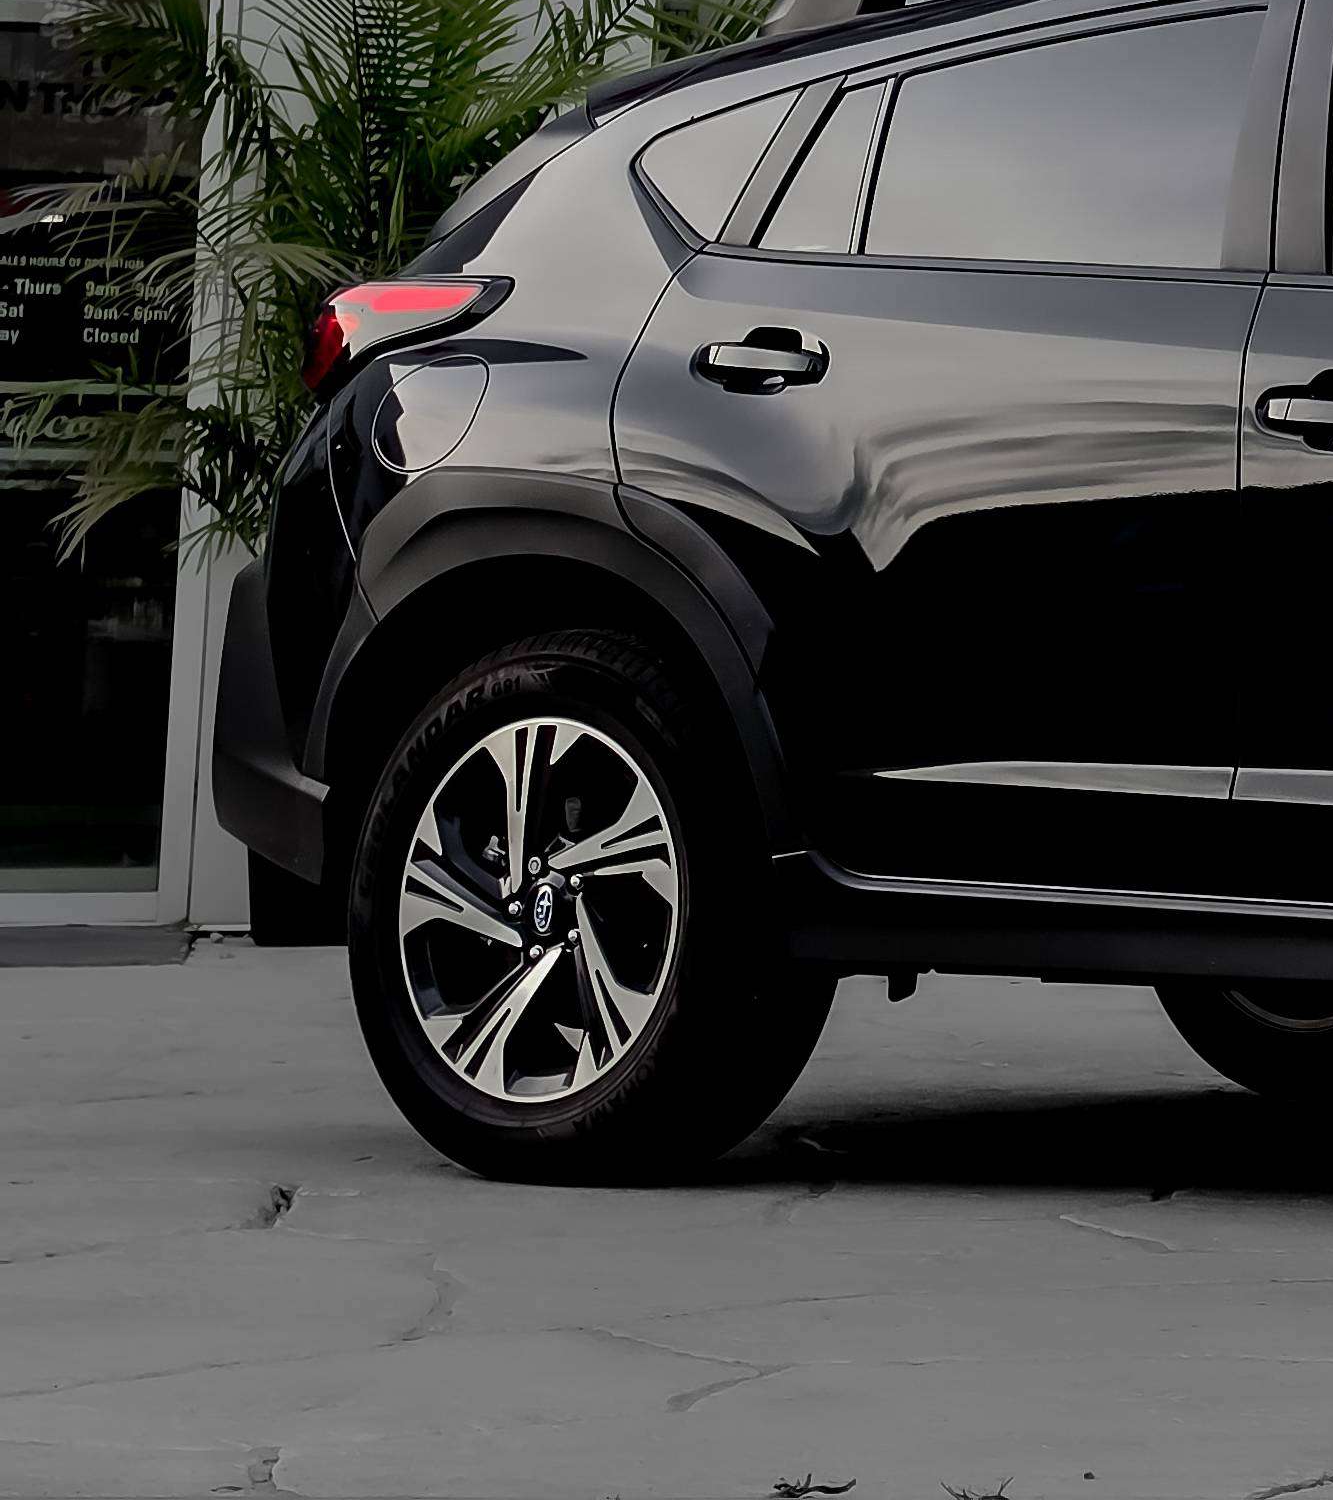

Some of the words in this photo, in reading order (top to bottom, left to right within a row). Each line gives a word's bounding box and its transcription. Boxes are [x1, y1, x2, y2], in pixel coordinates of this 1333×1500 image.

[29, 256, 66, 268] HOURS
[14, 278, 62, 295] Thurs
[83, 303, 119, 321] 9am
[133, 305, 168, 324] 6pm
[83, 327, 140, 344] Closed
